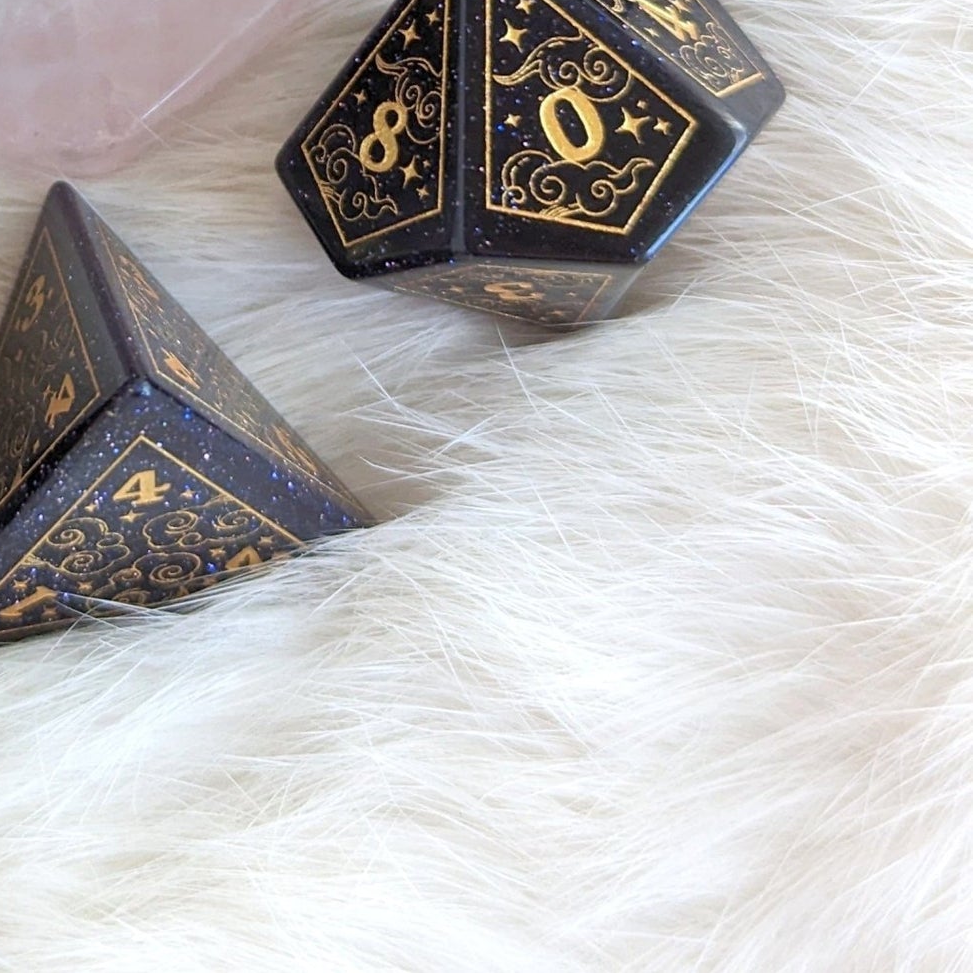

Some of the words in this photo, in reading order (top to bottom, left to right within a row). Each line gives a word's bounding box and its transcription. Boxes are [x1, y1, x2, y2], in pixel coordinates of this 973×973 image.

[360, 100, 408, 173] 8
[540, 86, 605, 164] 0
[112, 469, 171, 506] 4
